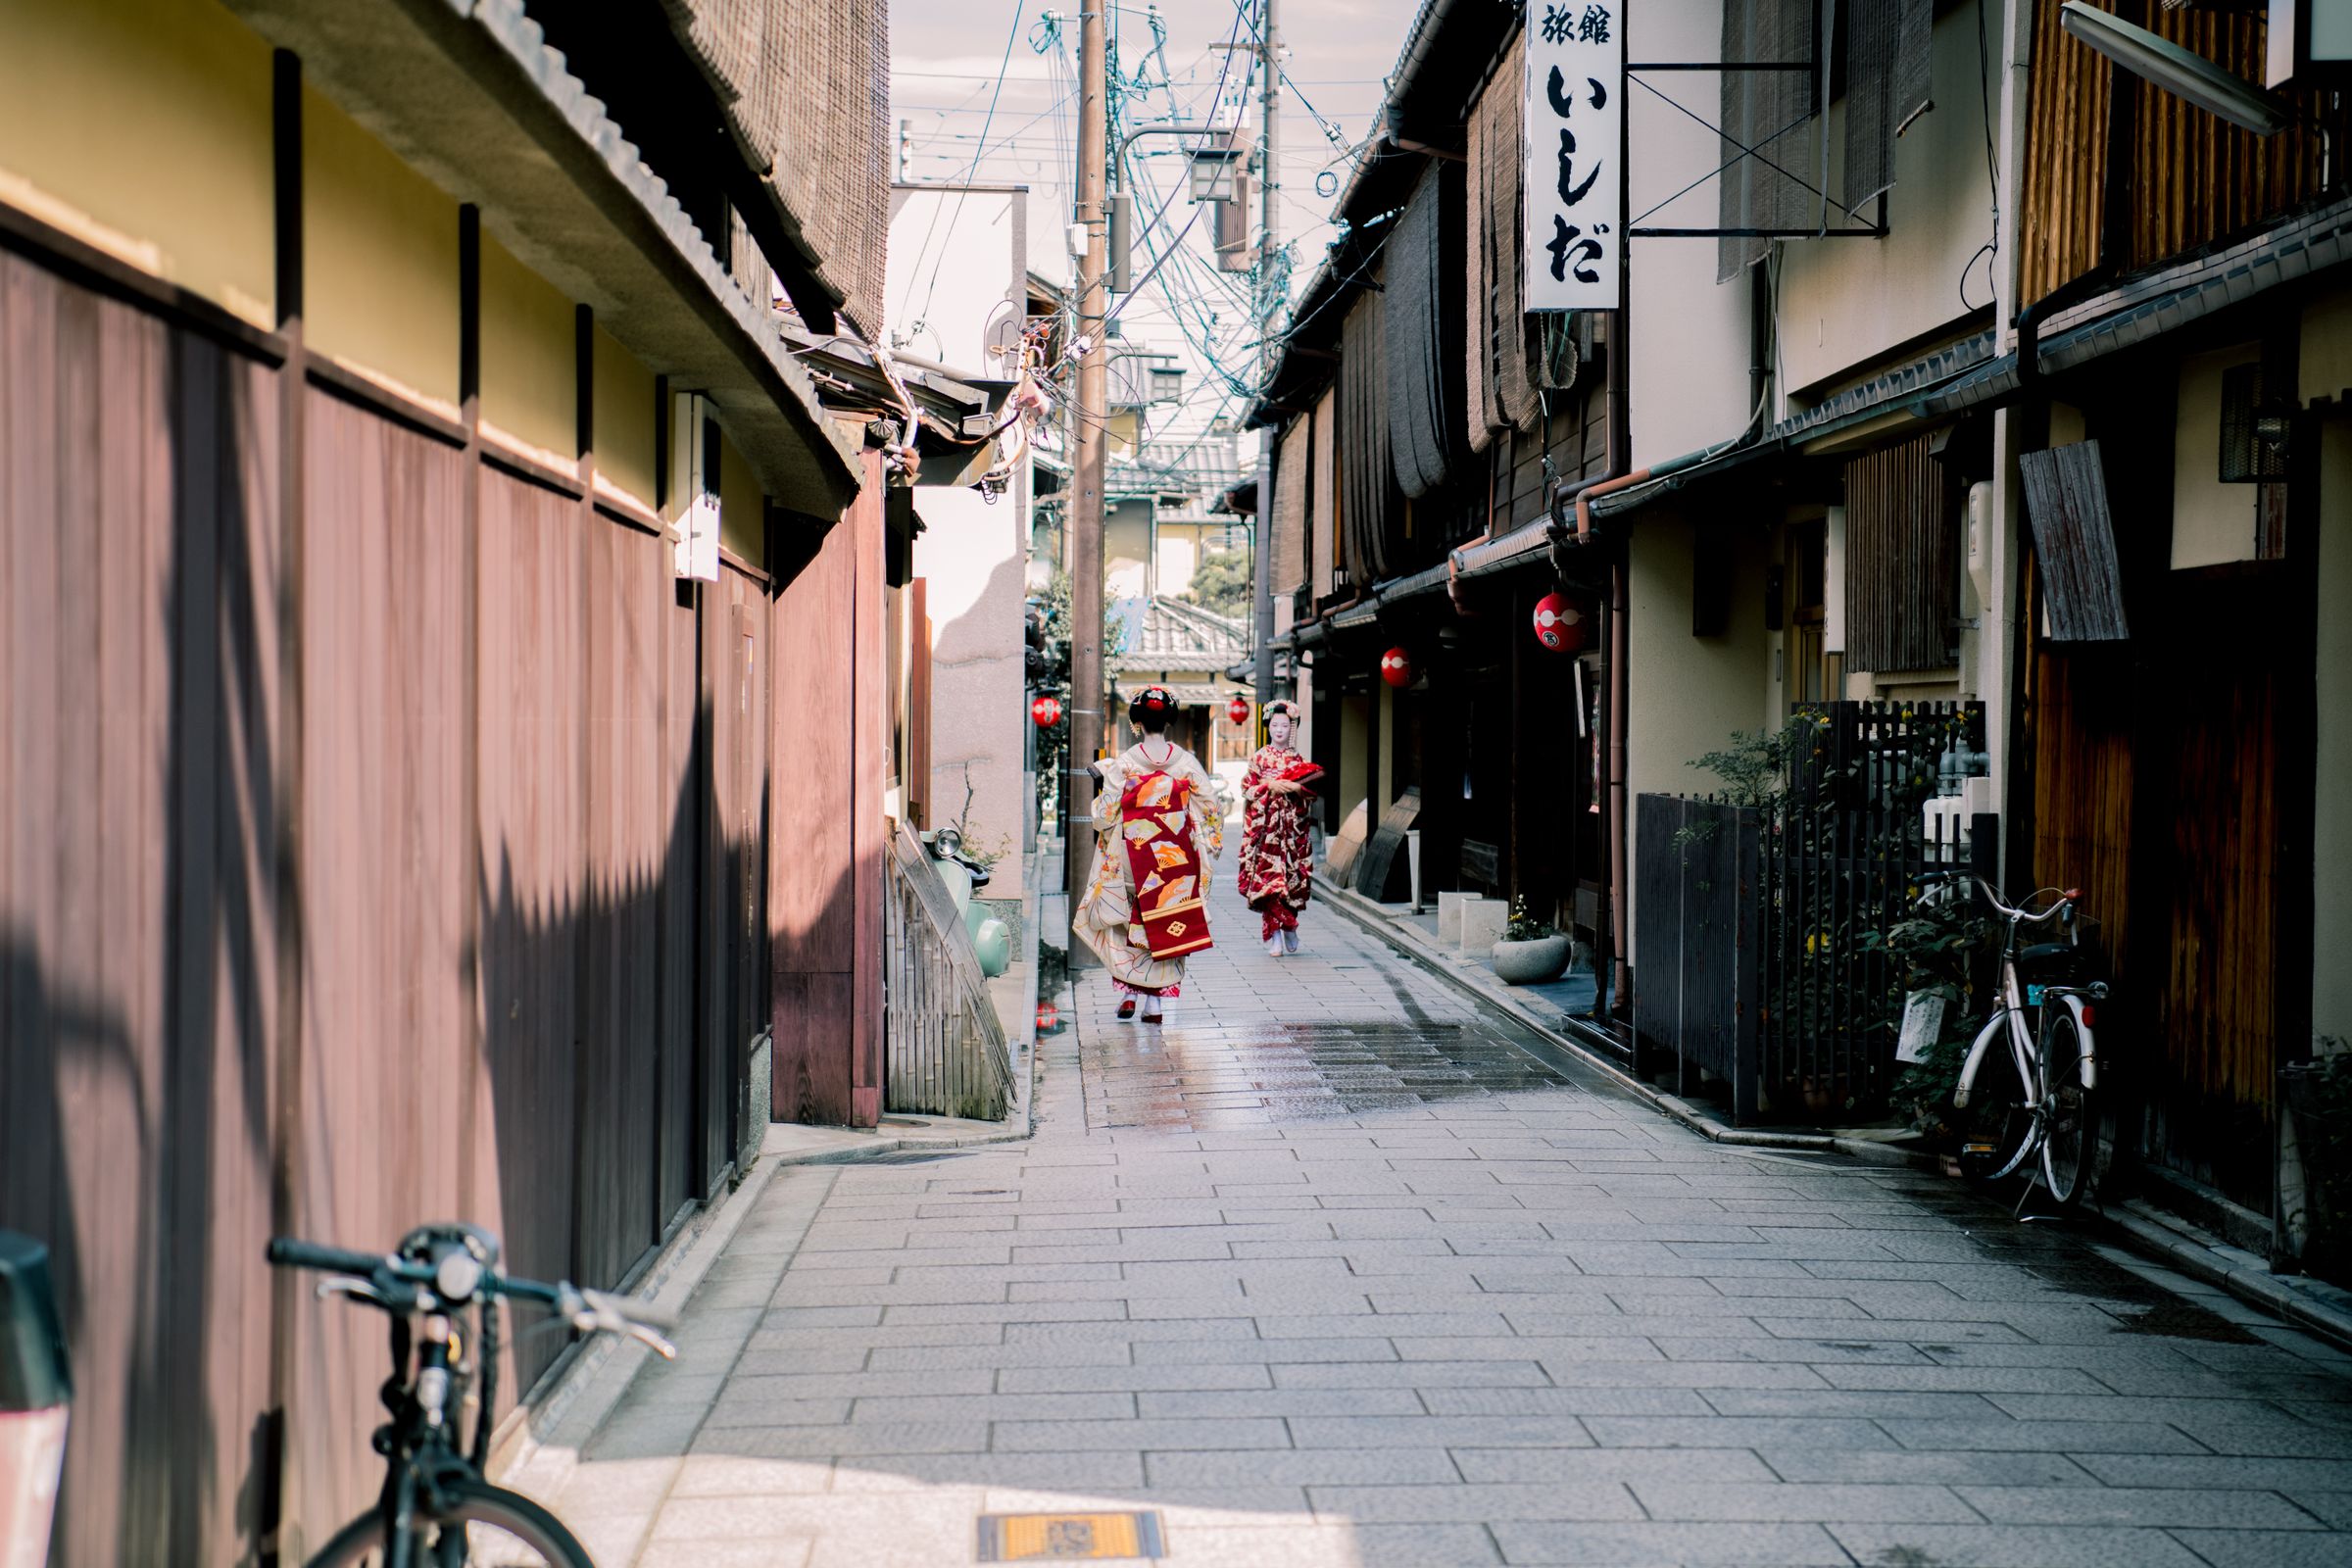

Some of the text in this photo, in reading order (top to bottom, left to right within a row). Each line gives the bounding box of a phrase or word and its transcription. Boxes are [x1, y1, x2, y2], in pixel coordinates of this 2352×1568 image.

[1542, 4, 1611, 45] 旅館
[1545, 65, 1609, 283] いしだ
